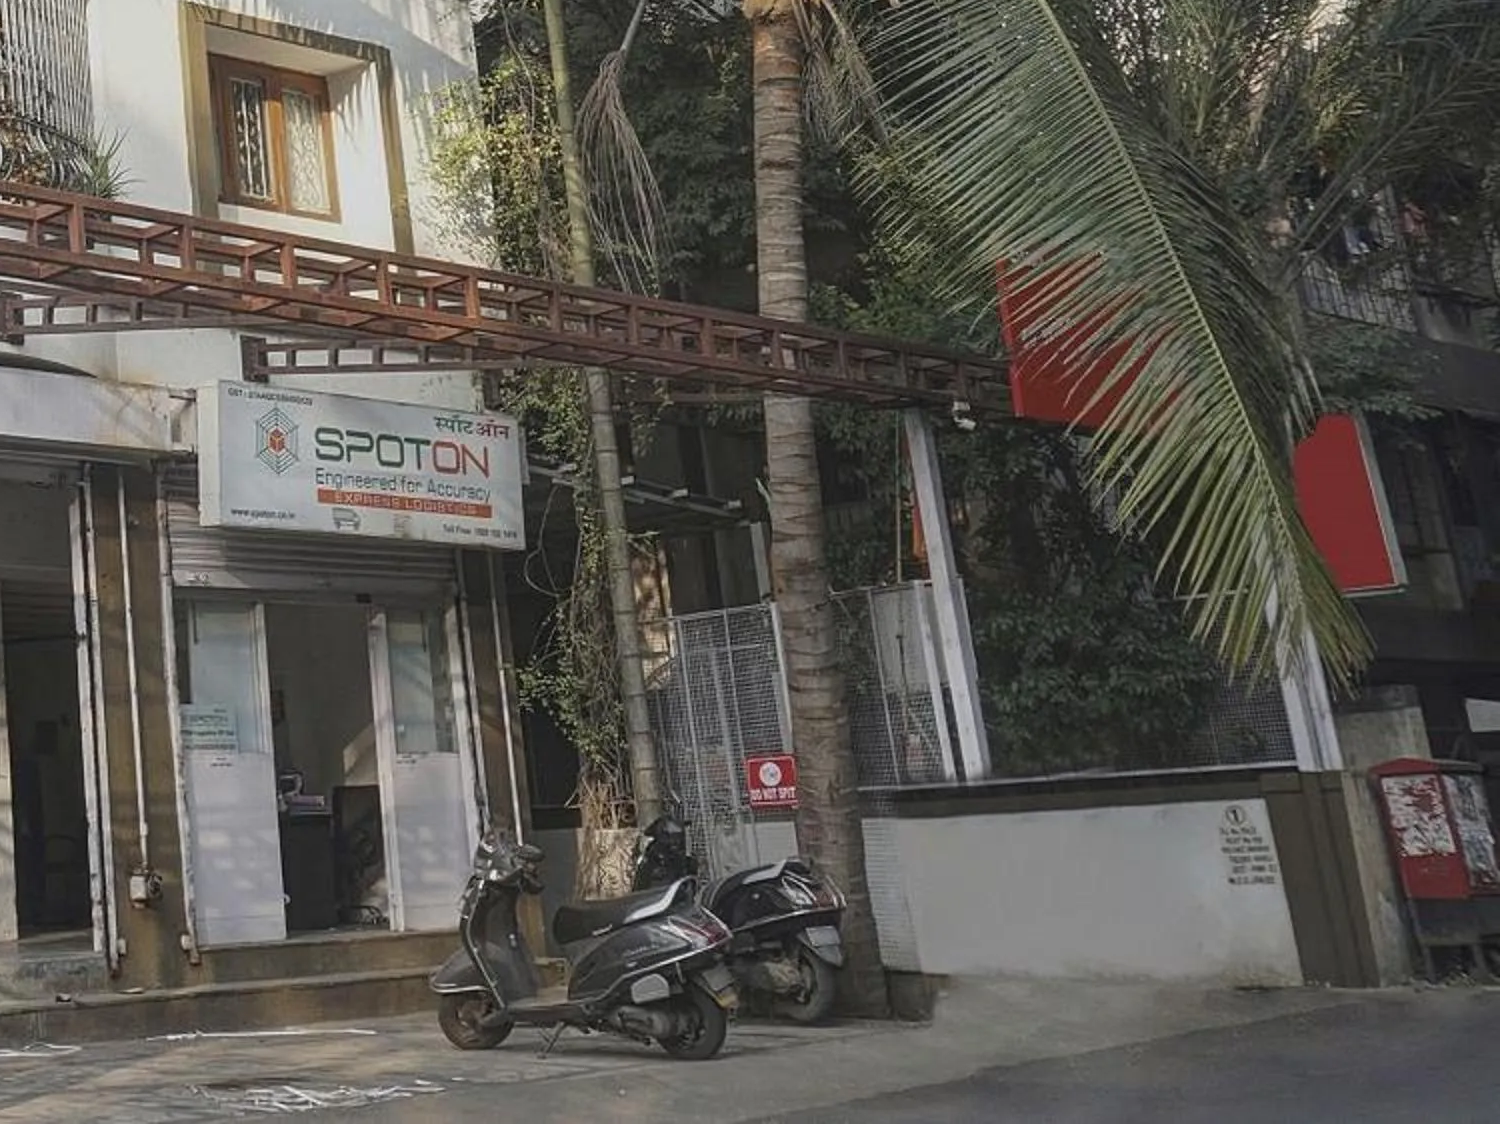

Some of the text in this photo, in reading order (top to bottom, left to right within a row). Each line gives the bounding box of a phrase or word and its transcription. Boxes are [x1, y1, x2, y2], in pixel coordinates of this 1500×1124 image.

[315, 427, 490, 478] SPOTON
[315, 467, 491, 503] Engineered for Accuracy
